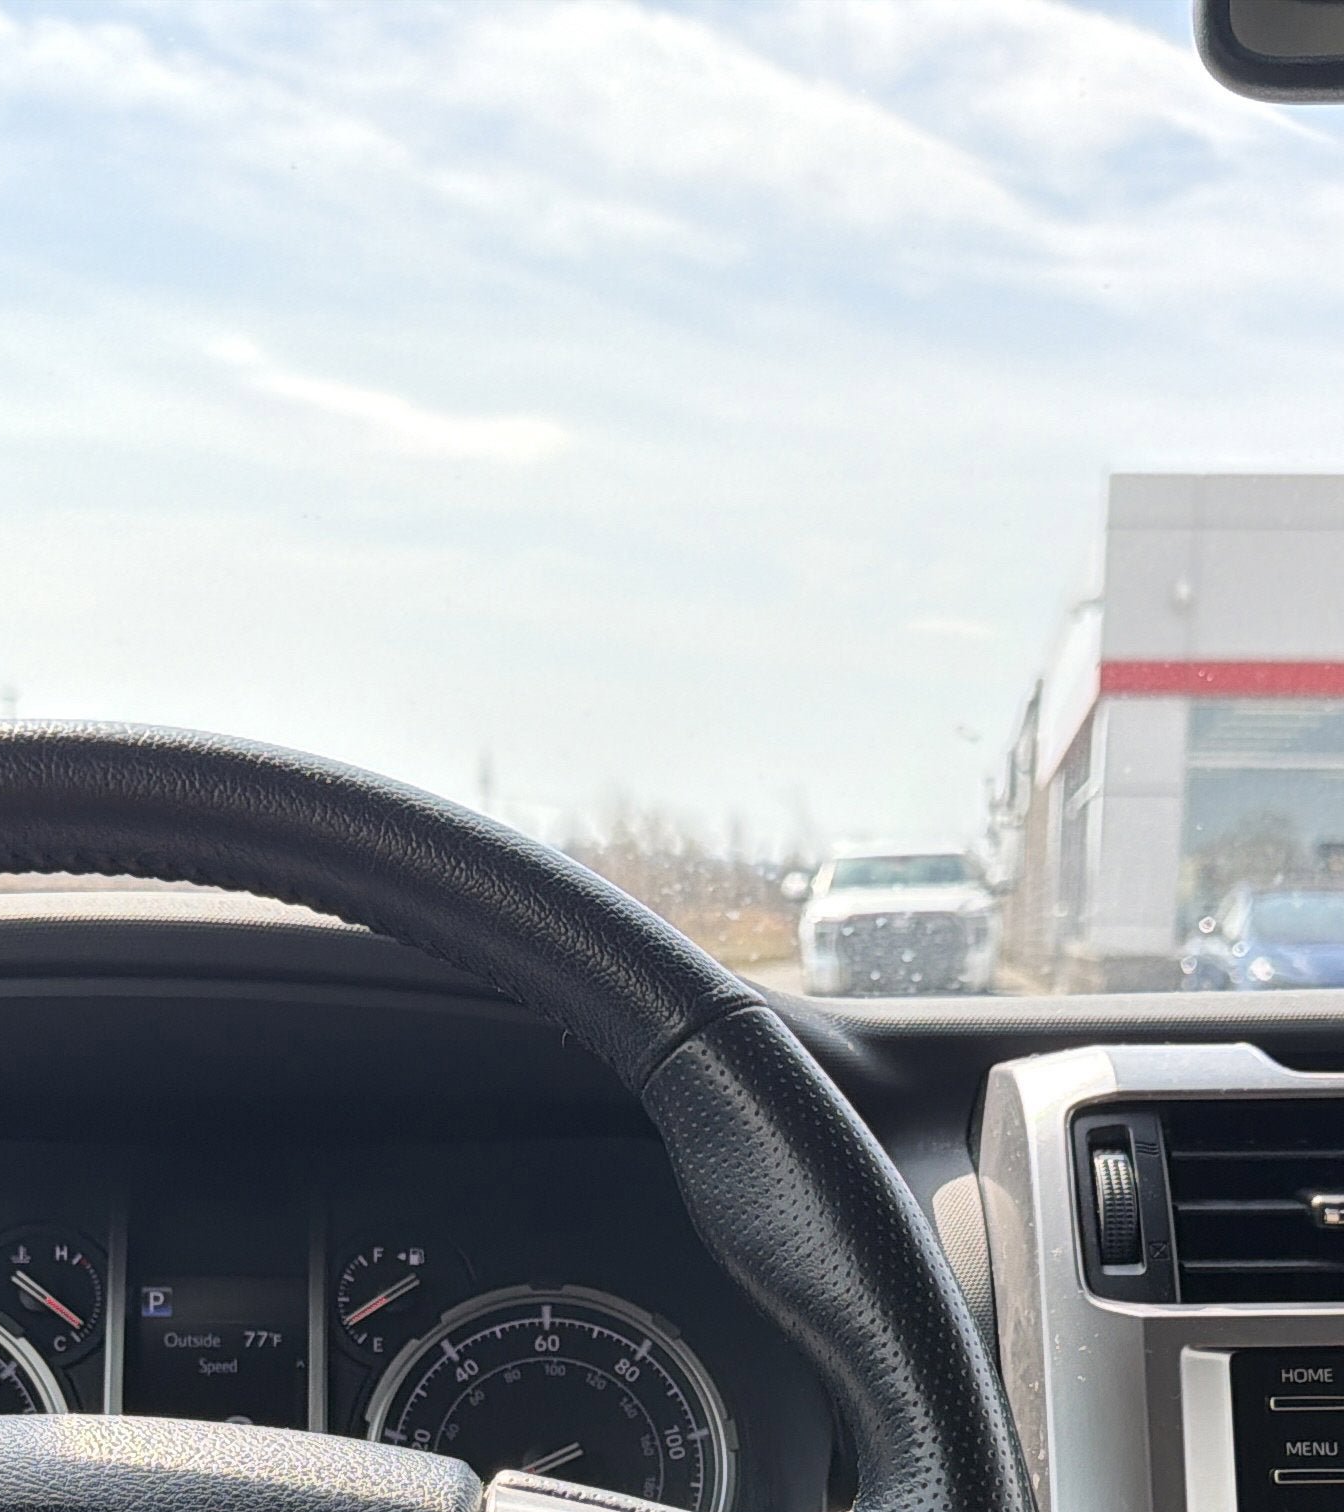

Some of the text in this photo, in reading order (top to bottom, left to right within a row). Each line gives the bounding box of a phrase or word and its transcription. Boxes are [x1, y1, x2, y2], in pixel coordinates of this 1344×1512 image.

[55, 1246, 68, 1260] H
[373, 1248, 384, 1263] F
[148, 1292, 165, 1313] P
[54, 1336, 67, 1351] C
[163, 1332, 221, 1348] Outside
[372, 1337, 384, 1352] E
[535, 1335, 560, 1352] 60
[199, 1358, 238, 1376] Speed
[456, 1359, 479, 1382] 40
[545, 1364, 566, 1377] 100
[614, 1358, 640, 1383] 80
[1281, 1368, 1333, 1384] HOME
[663, 1424, 686, 1460] 100
[1286, 1441, 1338, 1457] MENU
